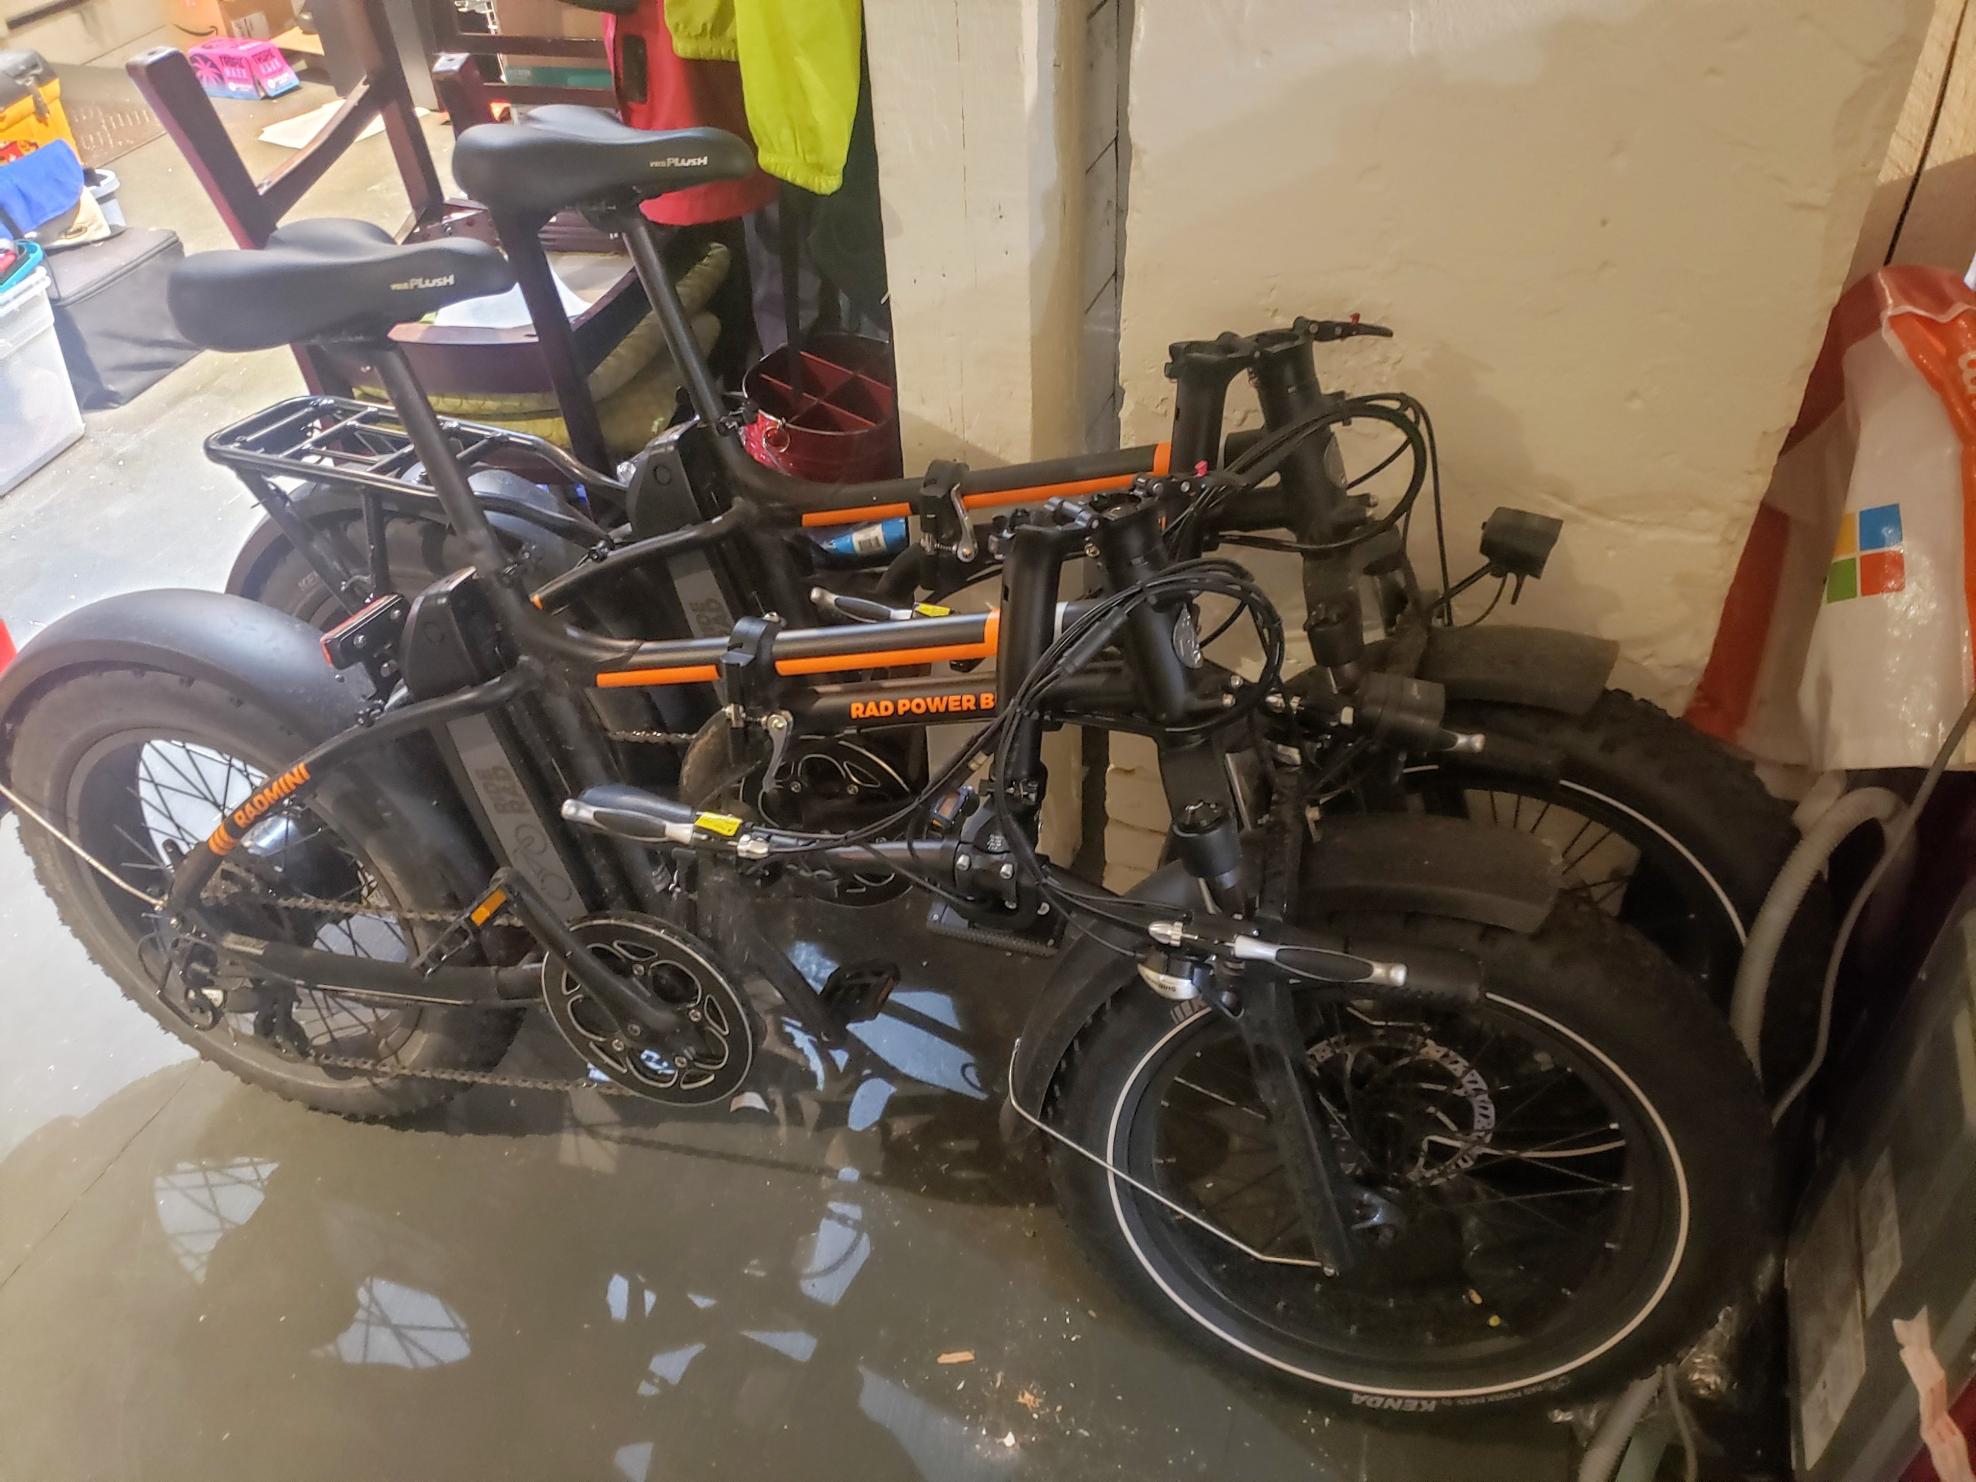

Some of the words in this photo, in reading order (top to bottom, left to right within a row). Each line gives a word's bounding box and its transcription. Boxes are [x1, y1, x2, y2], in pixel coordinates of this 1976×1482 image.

[666, 156, 708, 168] PLUSH
[850, 700, 895, 719] RAD
[897, 694, 976, 715] POWER
[233, 762, 311, 829] RADMINI
[1351, 1392, 1437, 1412] KENDA
